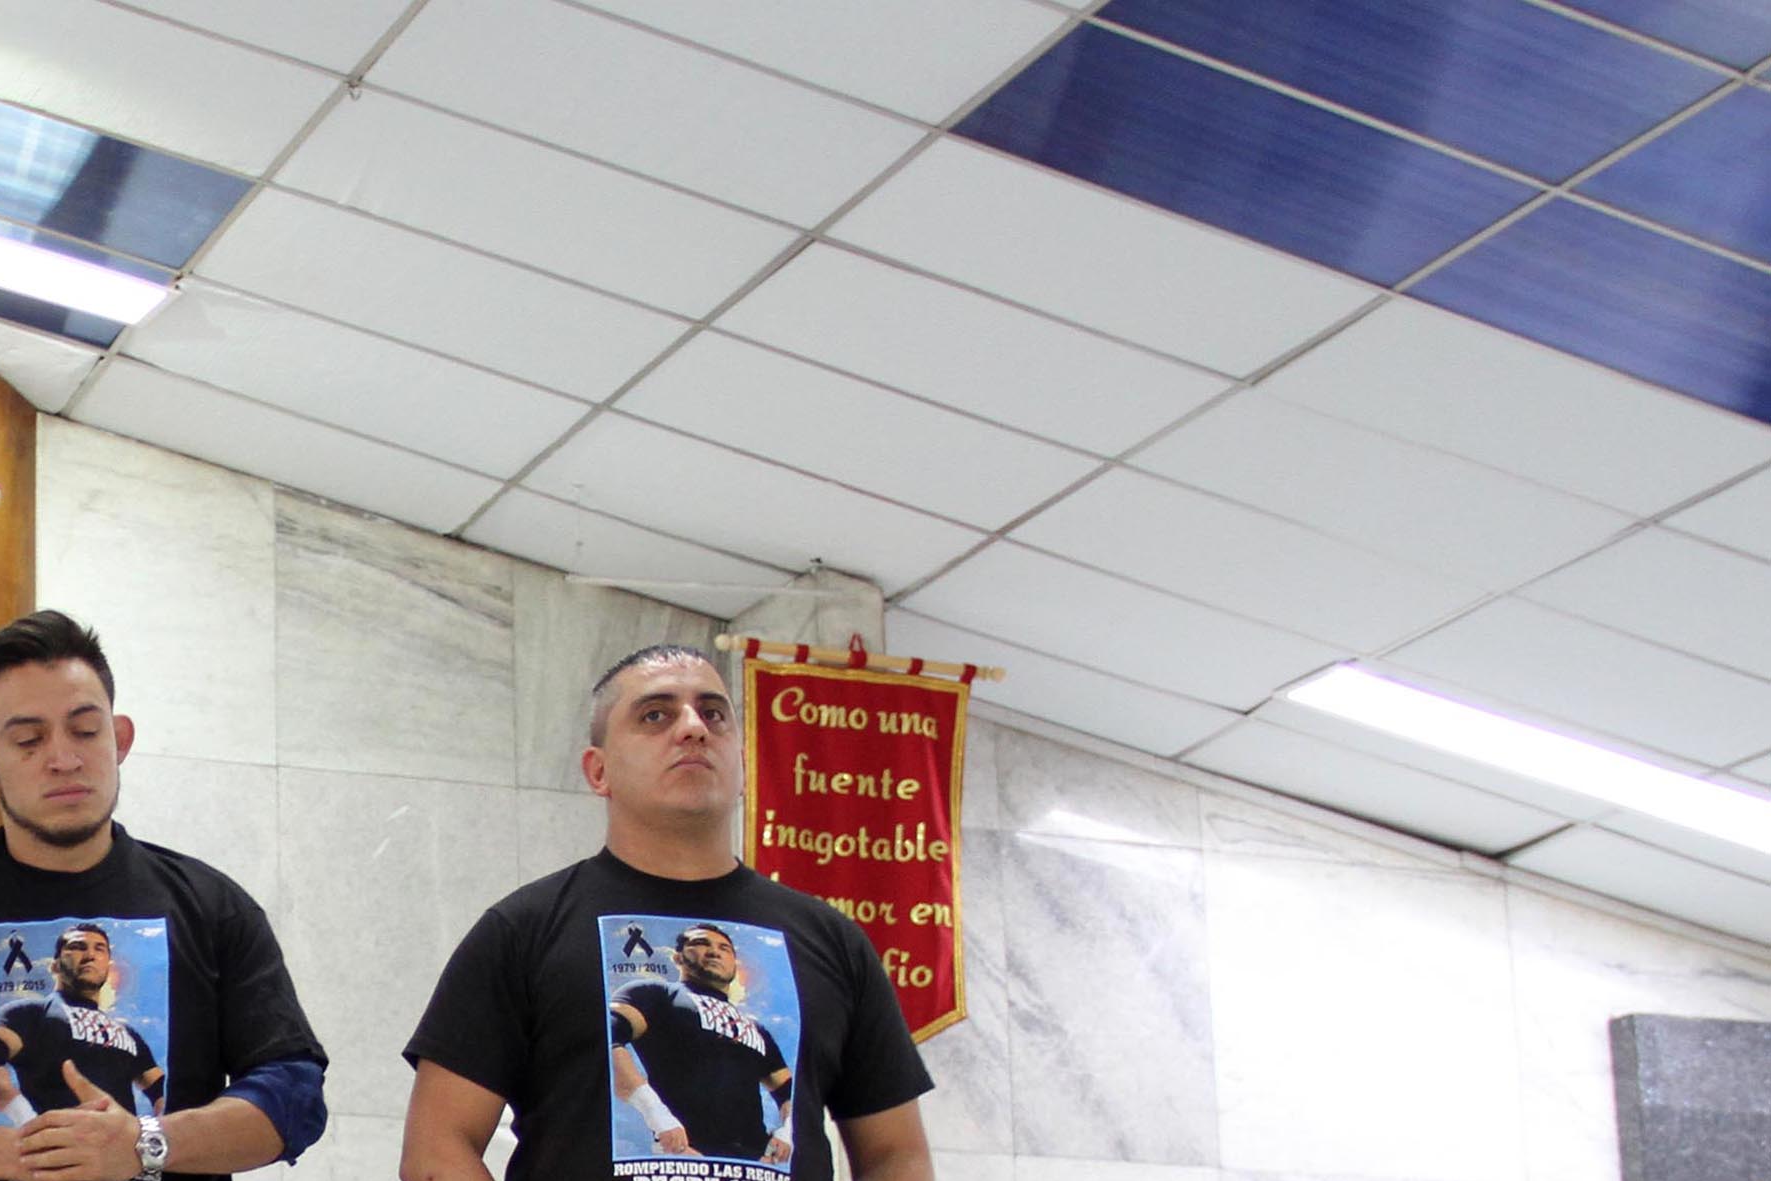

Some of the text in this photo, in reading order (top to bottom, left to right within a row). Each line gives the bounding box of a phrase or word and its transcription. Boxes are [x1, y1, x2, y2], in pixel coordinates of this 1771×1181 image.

[771, 687, 938, 739] Como una
[794, 753, 920, 799] fuente
[763, 810, 949, 865] inagotable
[910, 903, 952, 927] en
[612, 962, 636, 973] 1979
[645, 962, 668, 974] 2015
[22, 980, 46, 990] 2015
[613, 1161, 709, 1176] ROMPIENDO
[713, 1163, 743, 1179] LAS
